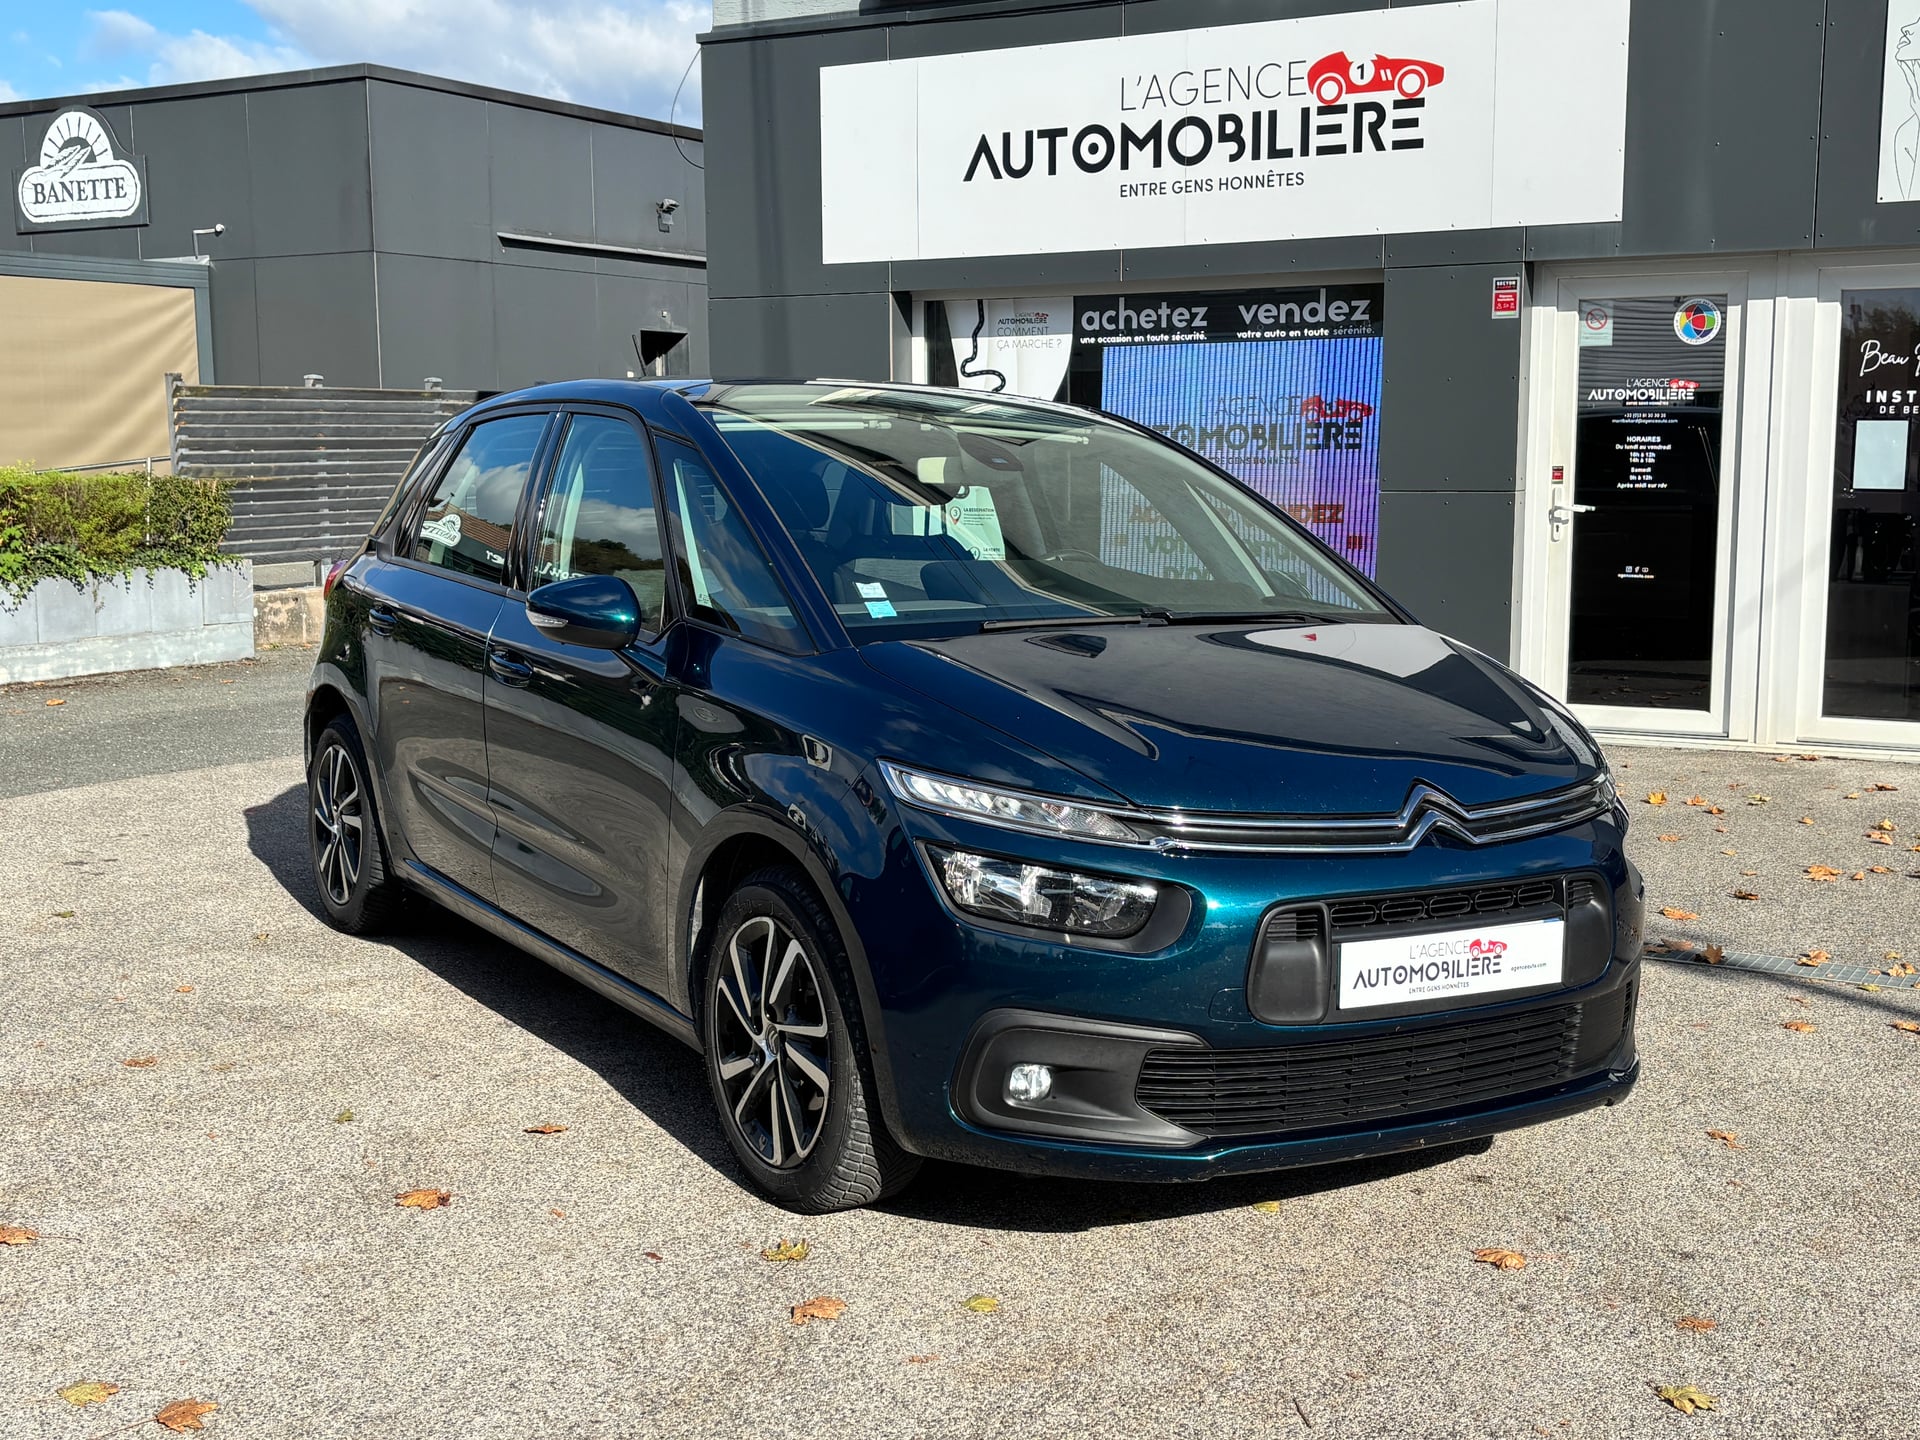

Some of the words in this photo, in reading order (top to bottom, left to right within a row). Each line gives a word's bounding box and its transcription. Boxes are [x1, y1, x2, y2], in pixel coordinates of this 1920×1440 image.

[1120, 60, 1307, 111] L'AGENCE
[962, 97, 1425, 182] AUTOMOBILIERE
[32, 177, 127, 205] BANETTE
[1120, 181, 1167, 197] ENTRE
[1171, 178, 1214, 195] GENS
[1218, 169, 1305, 191] HONNÊTES
[1081, 296, 1208, 331] achetez
[1238, 288, 1371, 325] vendez
[997, 326, 1049, 337] COMMENT
[1080, 336, 1095, 344] une
[1097, 334, 1132, 343] occasion
[1146, 333, 1169, 342] toute
[1171, 331, 1208, 341] sécurité.
[1236, 330, 1262, 339] votre
[1263, 330, 1286, 338] auto
[1288, 329, 1301, 337] en
[1303, 328, 1330, 337] toute
[1332, 324, 1375, 335] sérénité.
[997, 339, 1010, 351] ÇA
[1012, 338, 1054, 349] MARCHE
[1056, 338, 1062, 348] ?
[1859, 339, 1910, 377] Beau
[1626, 378, 1670, 388] L'AGENCE
[1587, 388, 1695, 401] AUTOMOBILIERE
[1879, 405, 1896, 415] DE
[1626, 435, 1661, 443] HORAIRES
[1409, 940, 1470, 959] L'AGENCE
[1352, 954, 1503, 989] AUTOMOBILIERE
[1408, 986, 1426, 994] ENTRE
